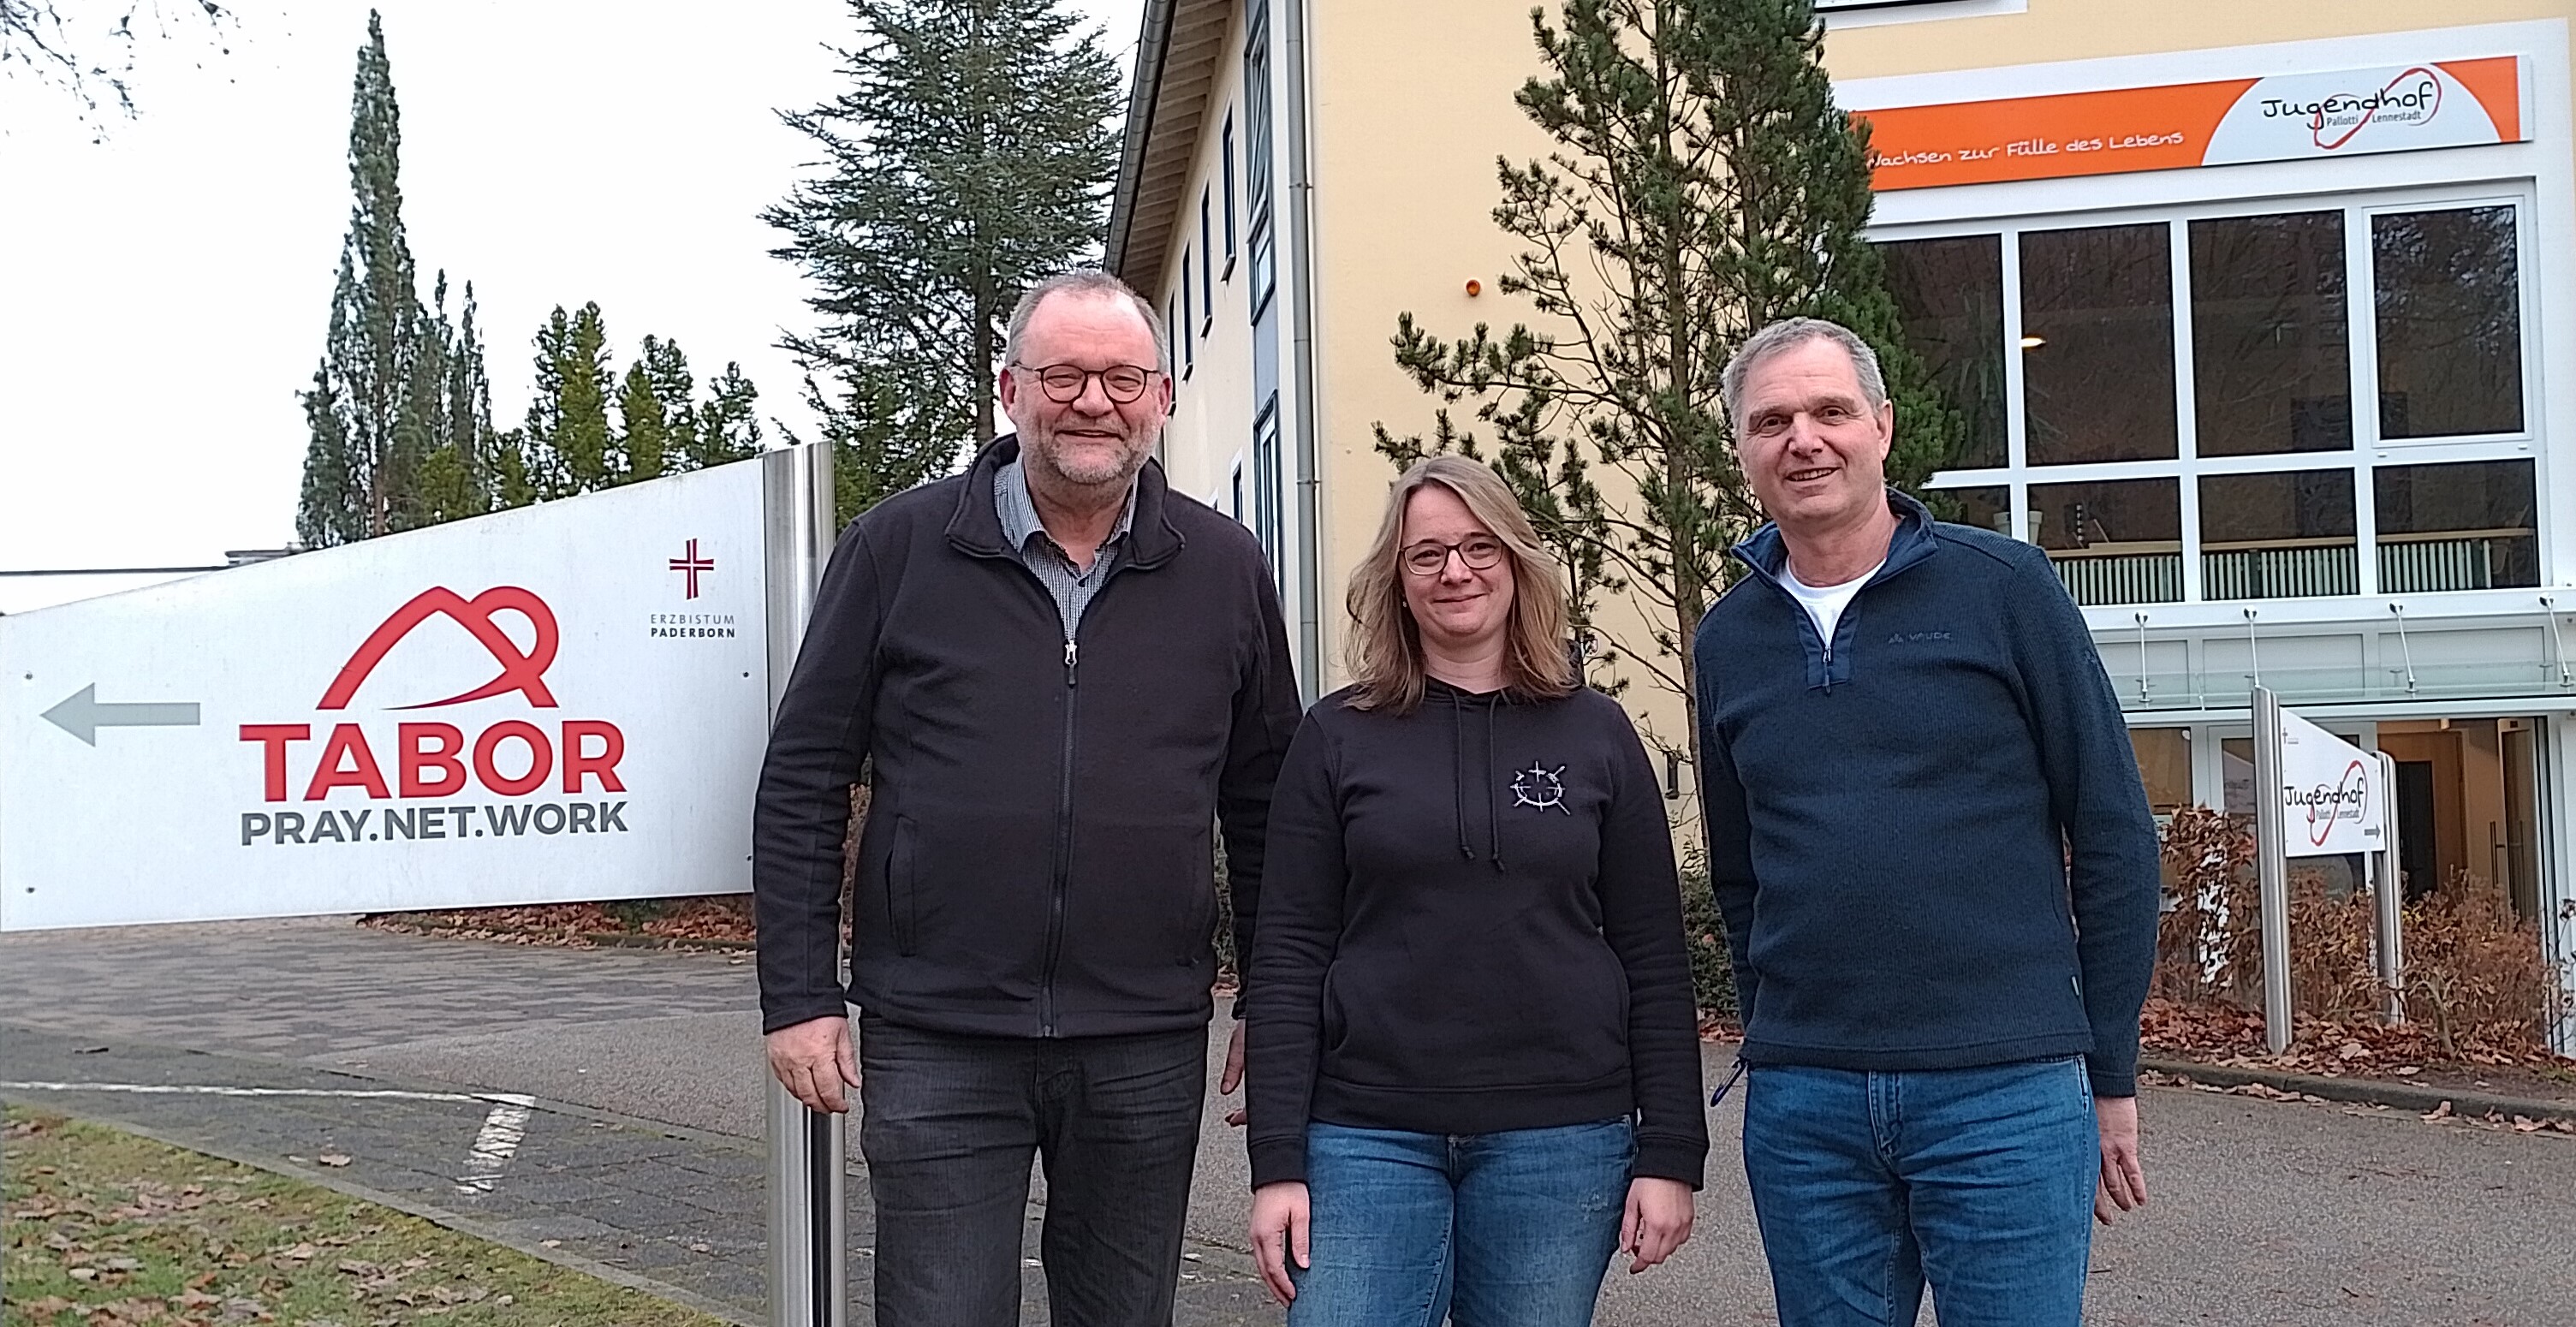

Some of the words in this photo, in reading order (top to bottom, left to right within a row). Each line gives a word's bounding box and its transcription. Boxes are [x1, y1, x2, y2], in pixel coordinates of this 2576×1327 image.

[2260, 81, 2433, 130] Jugendhof
[2327, 115, 2359, 127] Pallotti
[2372, 110, 2422, 123] Lennestadt
[1959, 146, 2000, 161] zur
[2007, 138, 2060, 157] Fülle
[2066, 139, 2103, 152] des
[2109, 132, 2184, 149] Lebens
[651, 614, 735, 625] ERZBISTUM
[651, 628, 735, 638] PADERBORN
[239, 720, 628, 802] TABOR
[2283, 777, 2364, 824] Jugendhof
[241, 801, 629, 846] PRAY.NET.WORK
